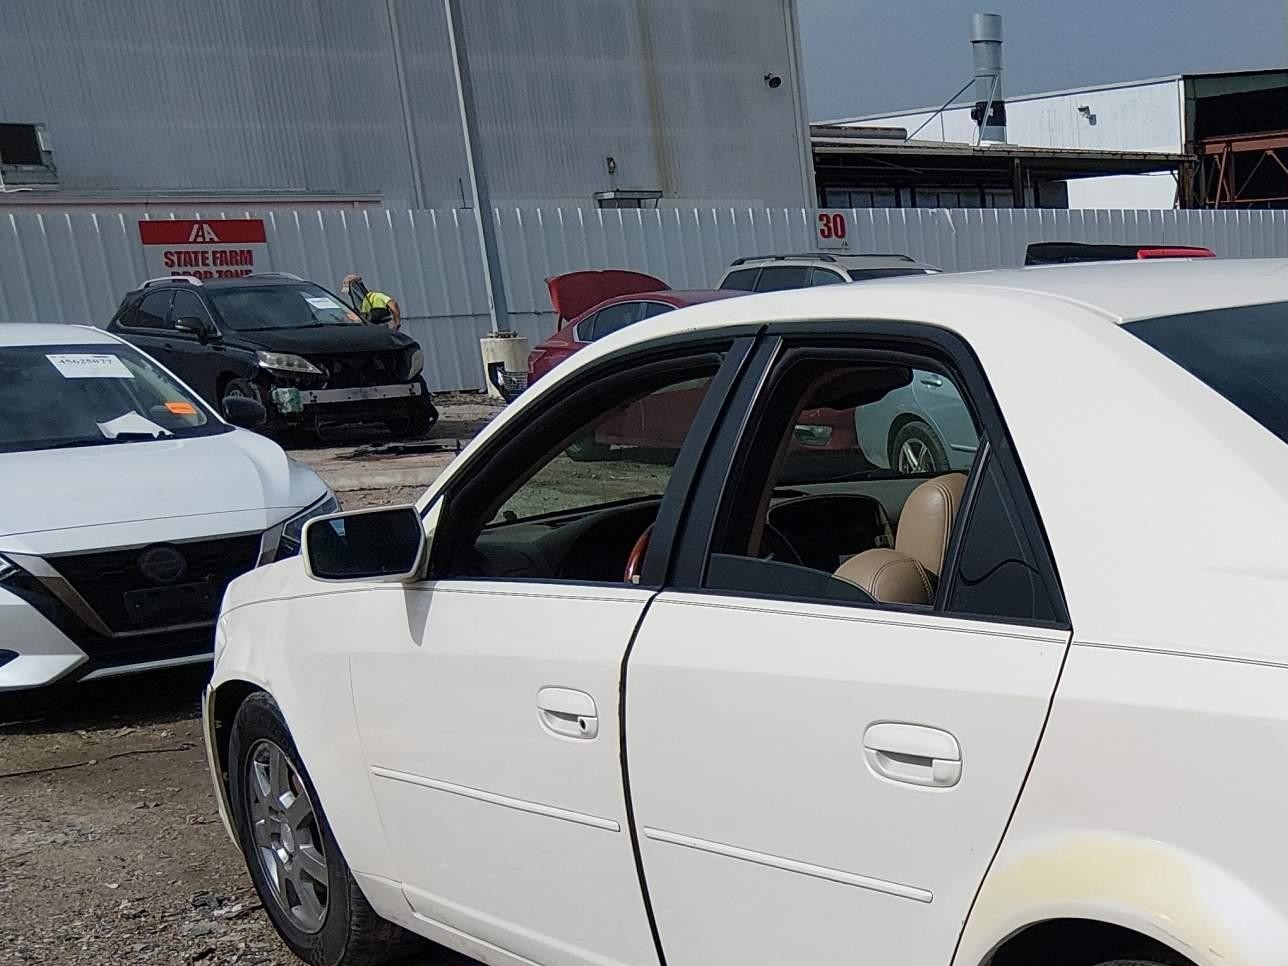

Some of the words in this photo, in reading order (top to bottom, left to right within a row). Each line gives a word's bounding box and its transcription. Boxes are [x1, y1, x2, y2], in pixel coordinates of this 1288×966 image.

[818, 213, 846, 239] 30
[163, 251, 209, 268] STATE
[212, 249, 254, 266] FARM
